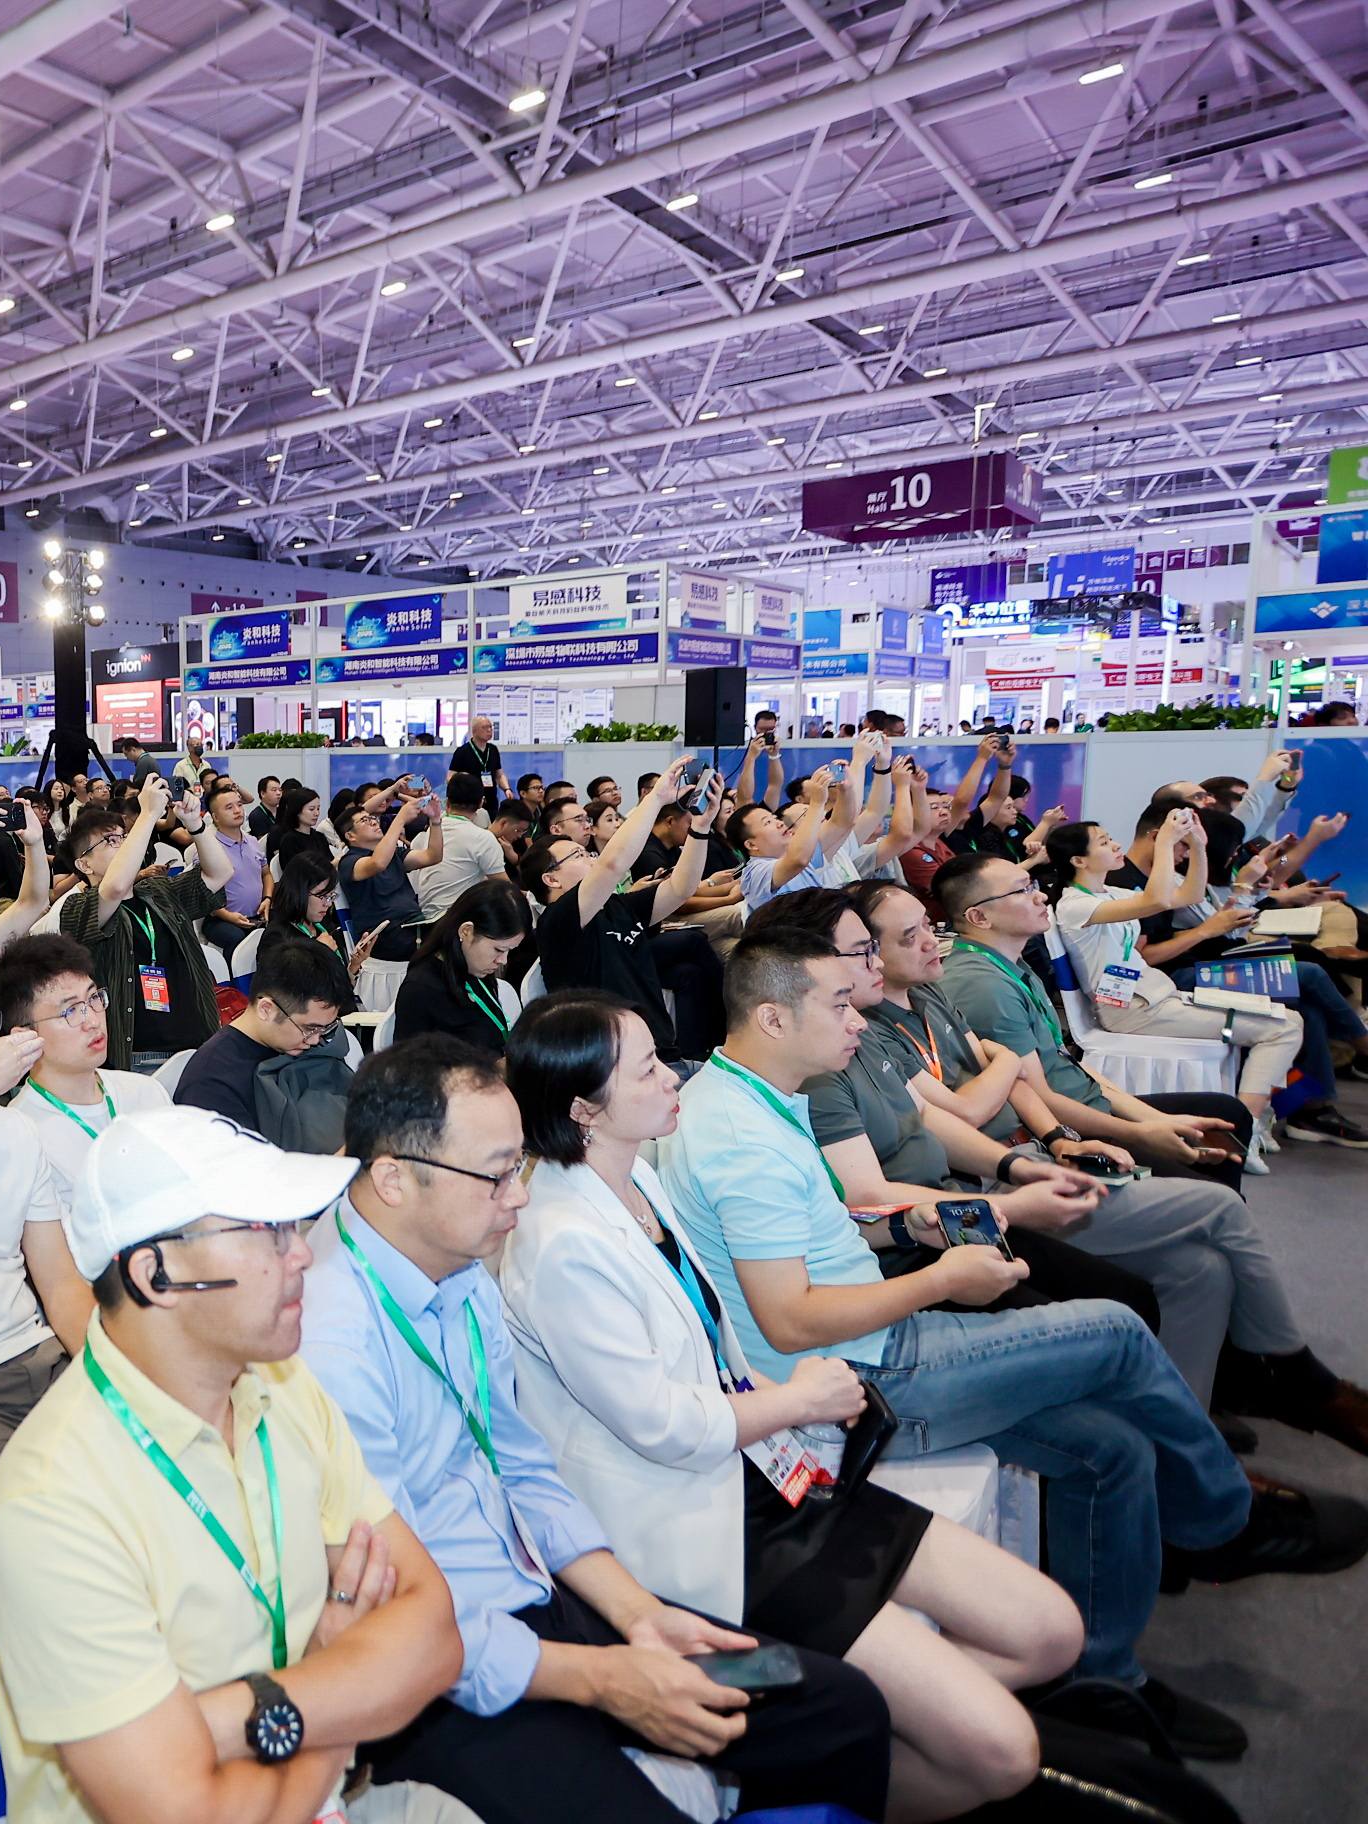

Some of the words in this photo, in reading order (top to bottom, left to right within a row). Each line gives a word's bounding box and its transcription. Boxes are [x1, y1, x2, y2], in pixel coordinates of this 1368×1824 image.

[890, 473, 932, 511] 10
[867, 504, 888, 515] Hall
[533, 585, 601, 607] 易感科技
[386, 608, 432, 626] 炎和科技
[243, 624, 281, 640] 炎和科技
[106, 658, 141, 677] ignion
[344, 654, 439, 670] 湖南炎和智能科技有限公司
